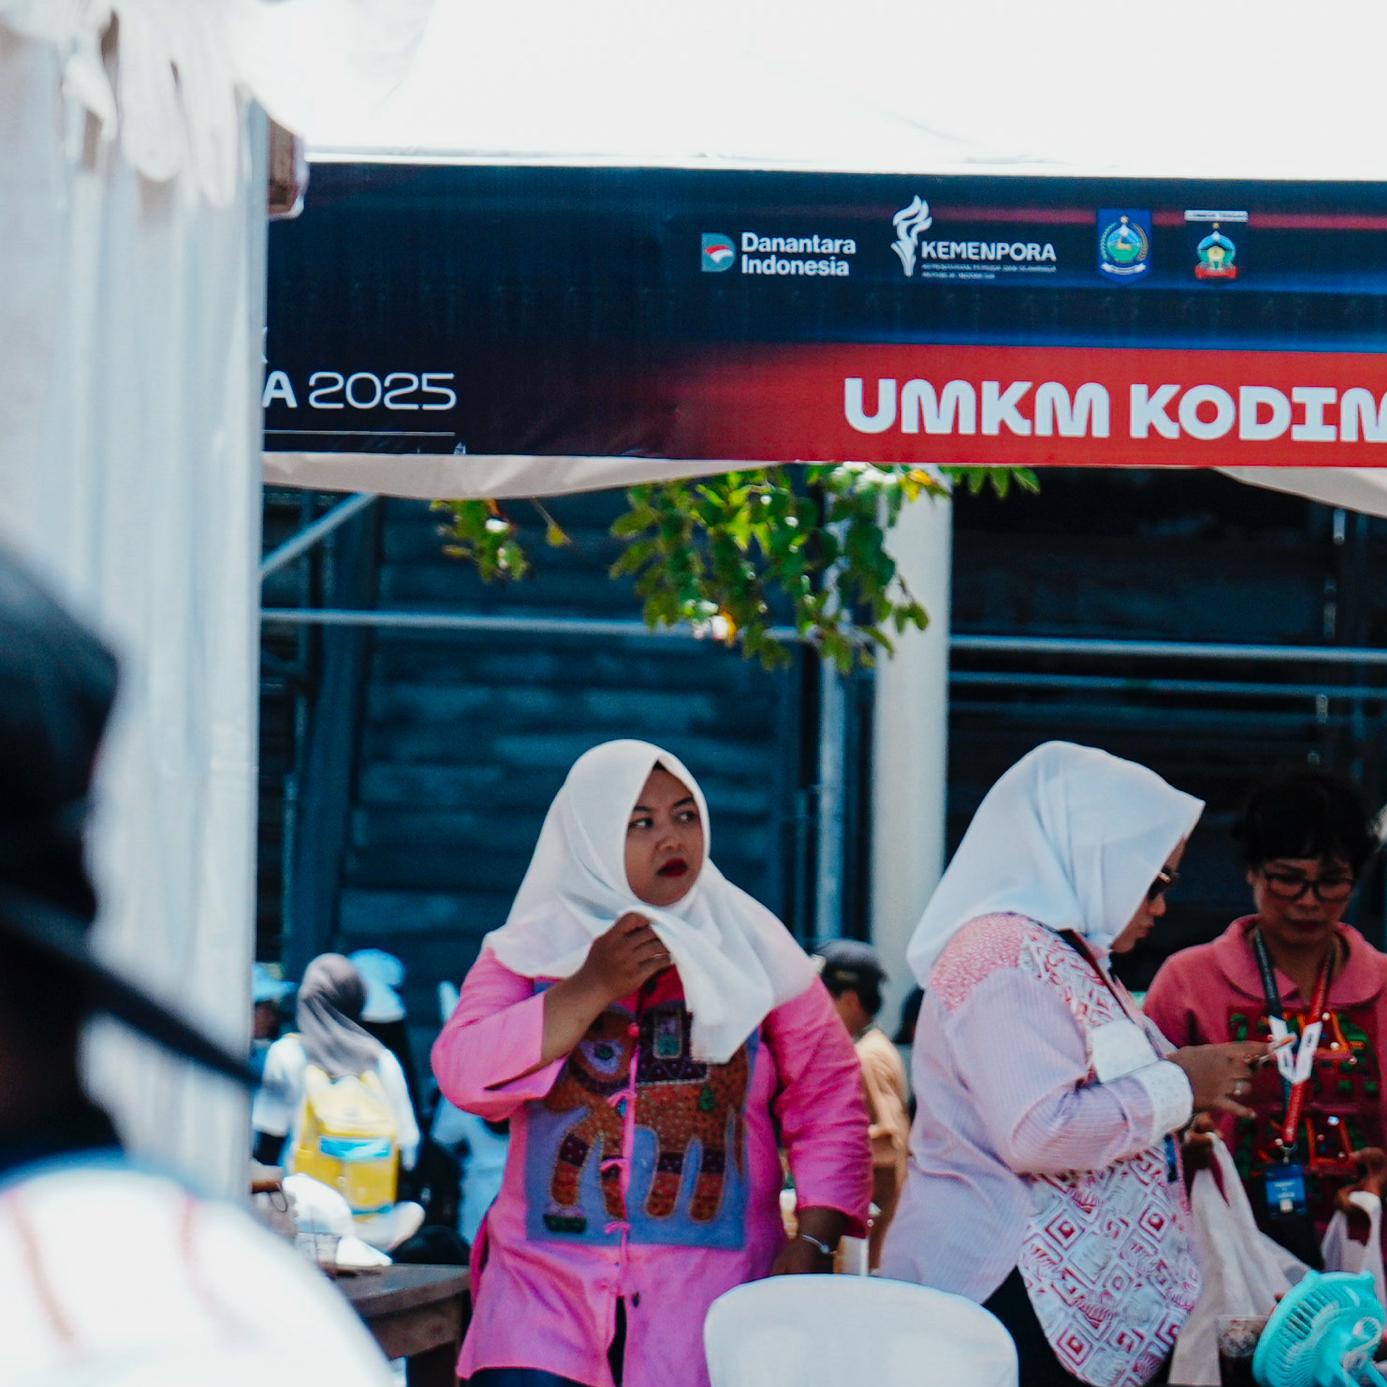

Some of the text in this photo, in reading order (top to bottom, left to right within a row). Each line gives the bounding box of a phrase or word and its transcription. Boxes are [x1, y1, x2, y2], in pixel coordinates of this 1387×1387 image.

[741, 232, 856, 256] Danantara
[921, 241, 1057, 262] KEMENPORA
[741, 254, 850, 277] Indonesia
[308, 371, 457, 410] 2025
[843, 377, 1110, 438] UMKM
